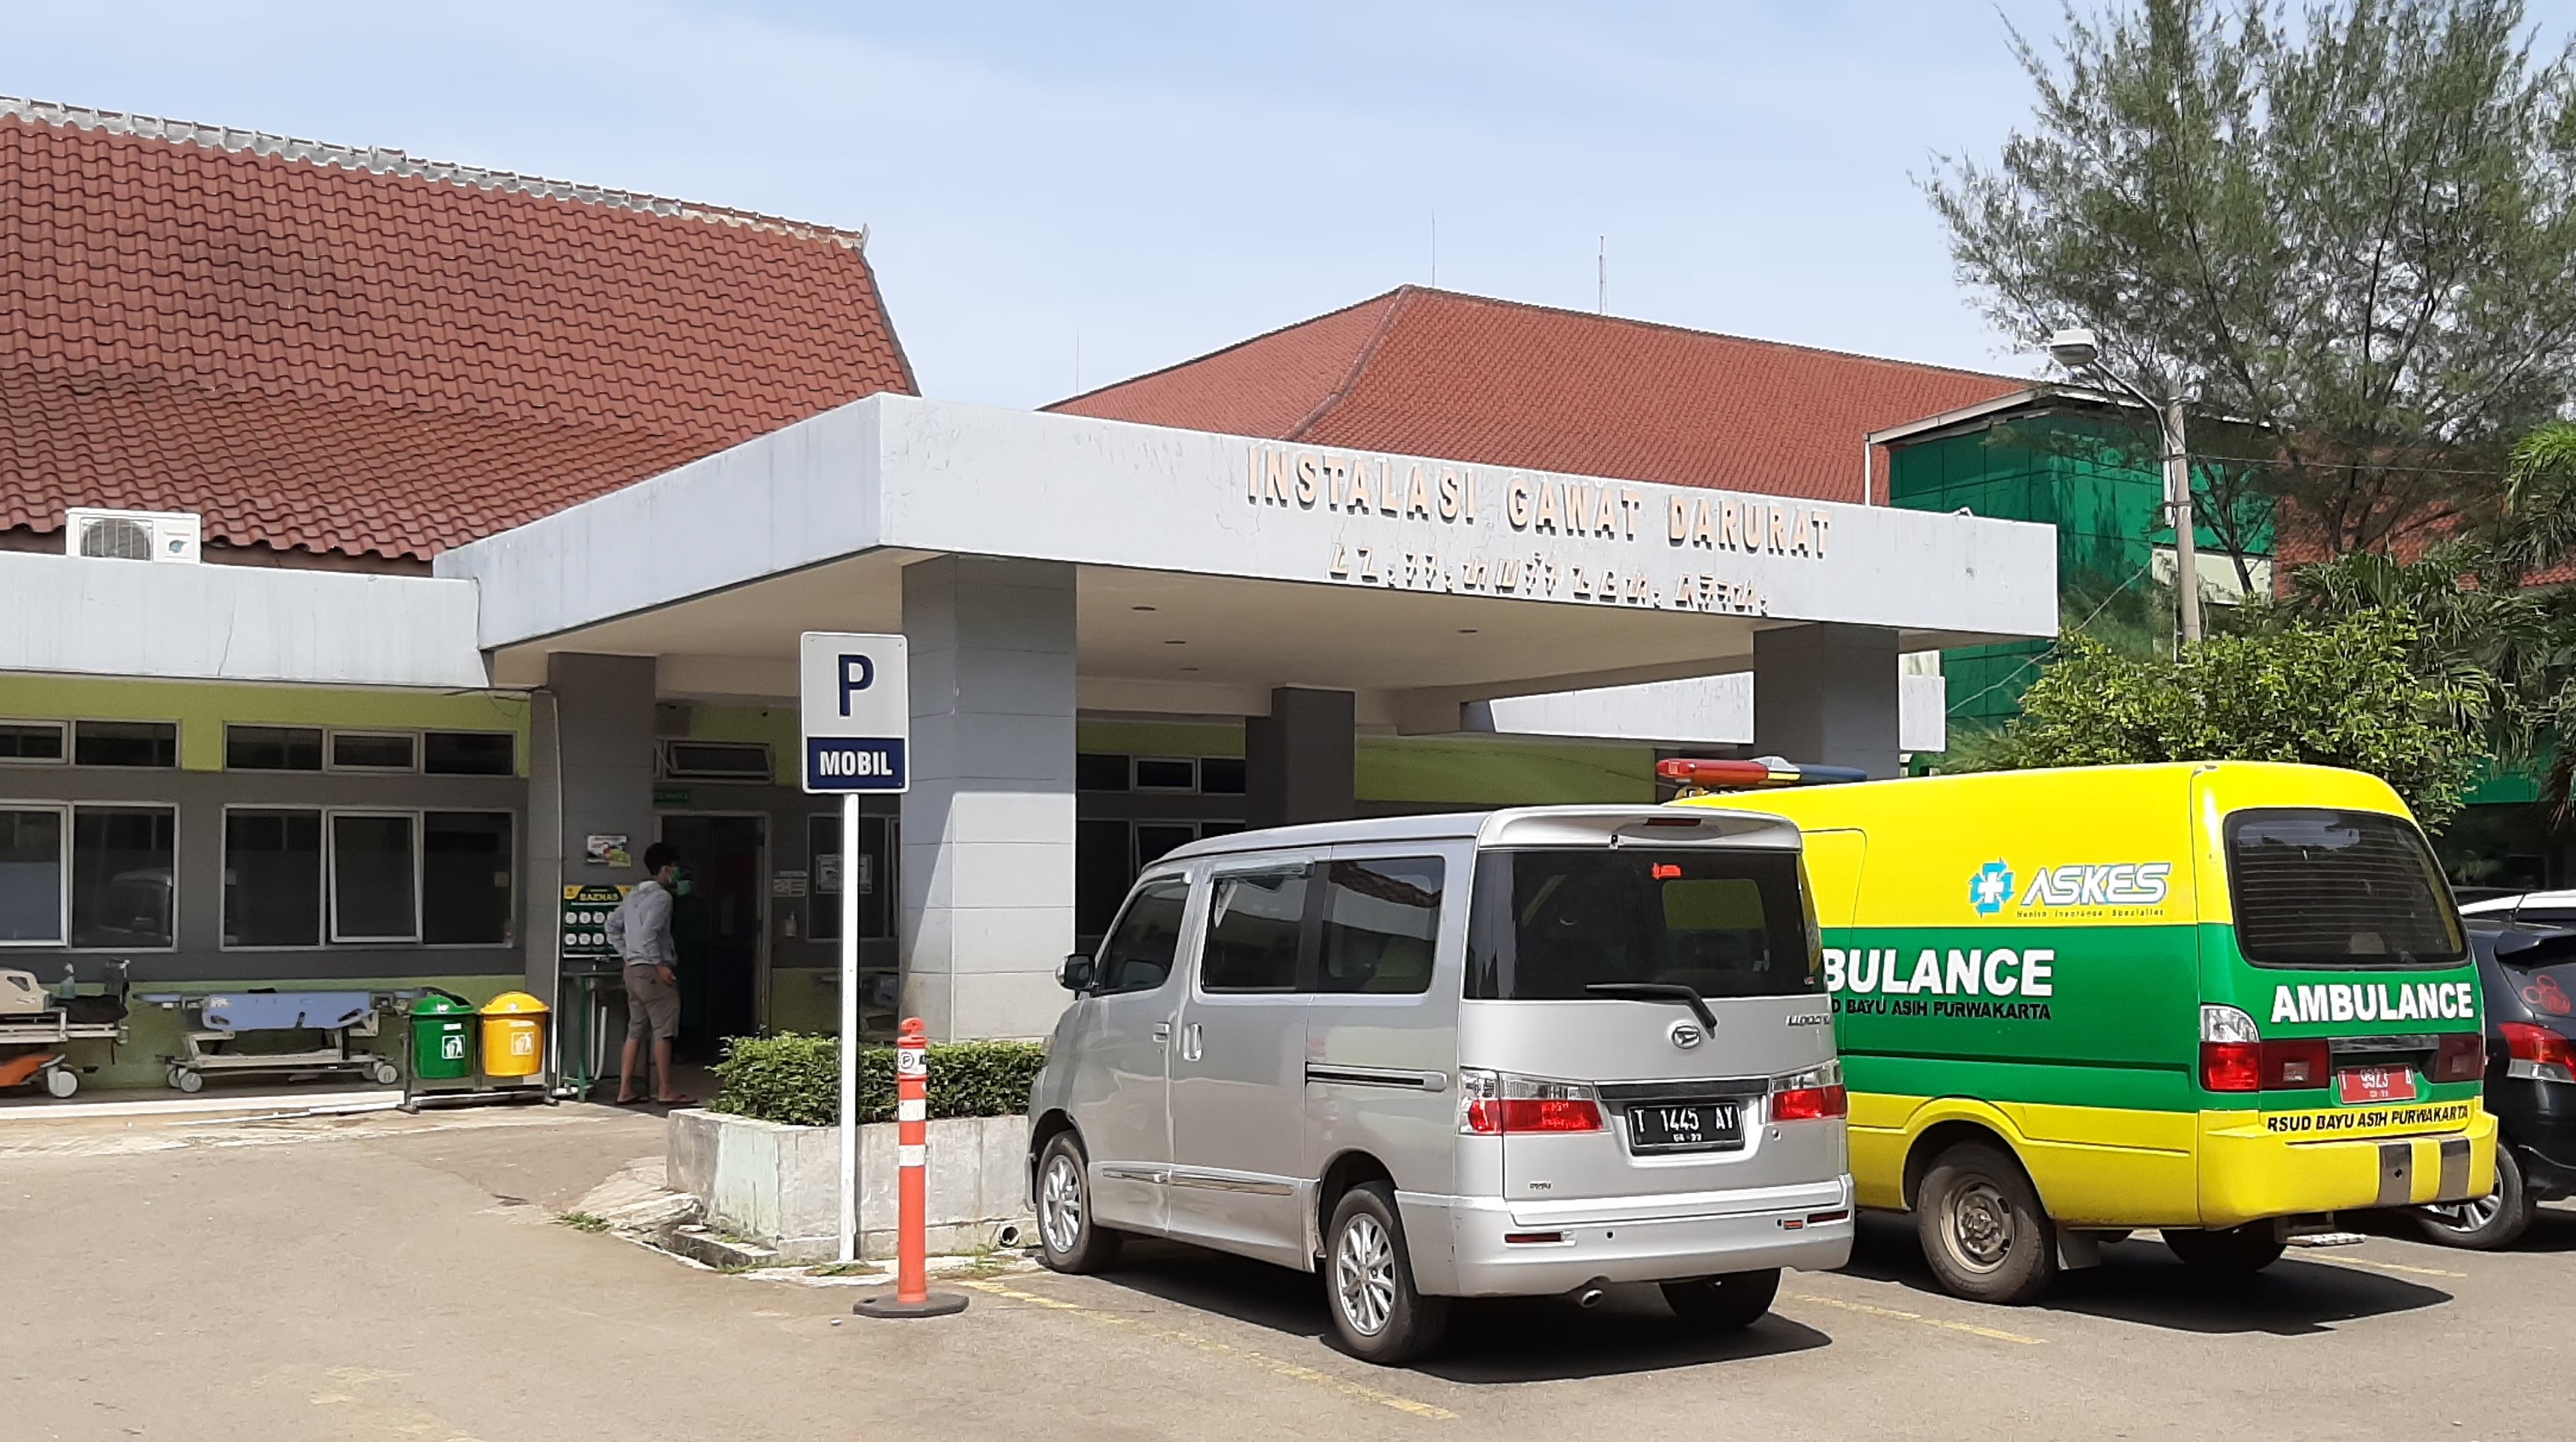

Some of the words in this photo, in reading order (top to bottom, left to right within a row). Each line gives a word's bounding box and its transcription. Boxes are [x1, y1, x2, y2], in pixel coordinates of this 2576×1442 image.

[1248, 446, 1477, 525] INSTALASI
[1506, 476, 1641, 542] GAWAT
[1667, 494, 1832, 559] DARURAT
[838, 653, 875, 717] P
[818, 750, 893, 777] MOBIL
[2019, 862, 2171, 907] ASKES
[1821, 947, 2055, 997] BULANCE
[1846, 998, 1887, 1015] BAYU
[1891, 999, 1928, 1017] ASIH
[1933, 1001, 2052, 1021] PURWAKARTA
[2270, 981, 2474, 1023] AMBULANCE
[1633, 1109, 1645, 1134] T
[1660, 1107, 1700, 1132] 1445
[1715, 1106, 1733, 1130] AY
[2267, 1117, 2312, 1133] RSUD
[2315, 1112, 2354, 1131] BAYU
[2357, 1111, 2387, 1128] ASIH
[2391, 1104, 2469, 1125] PURWAKARTA
